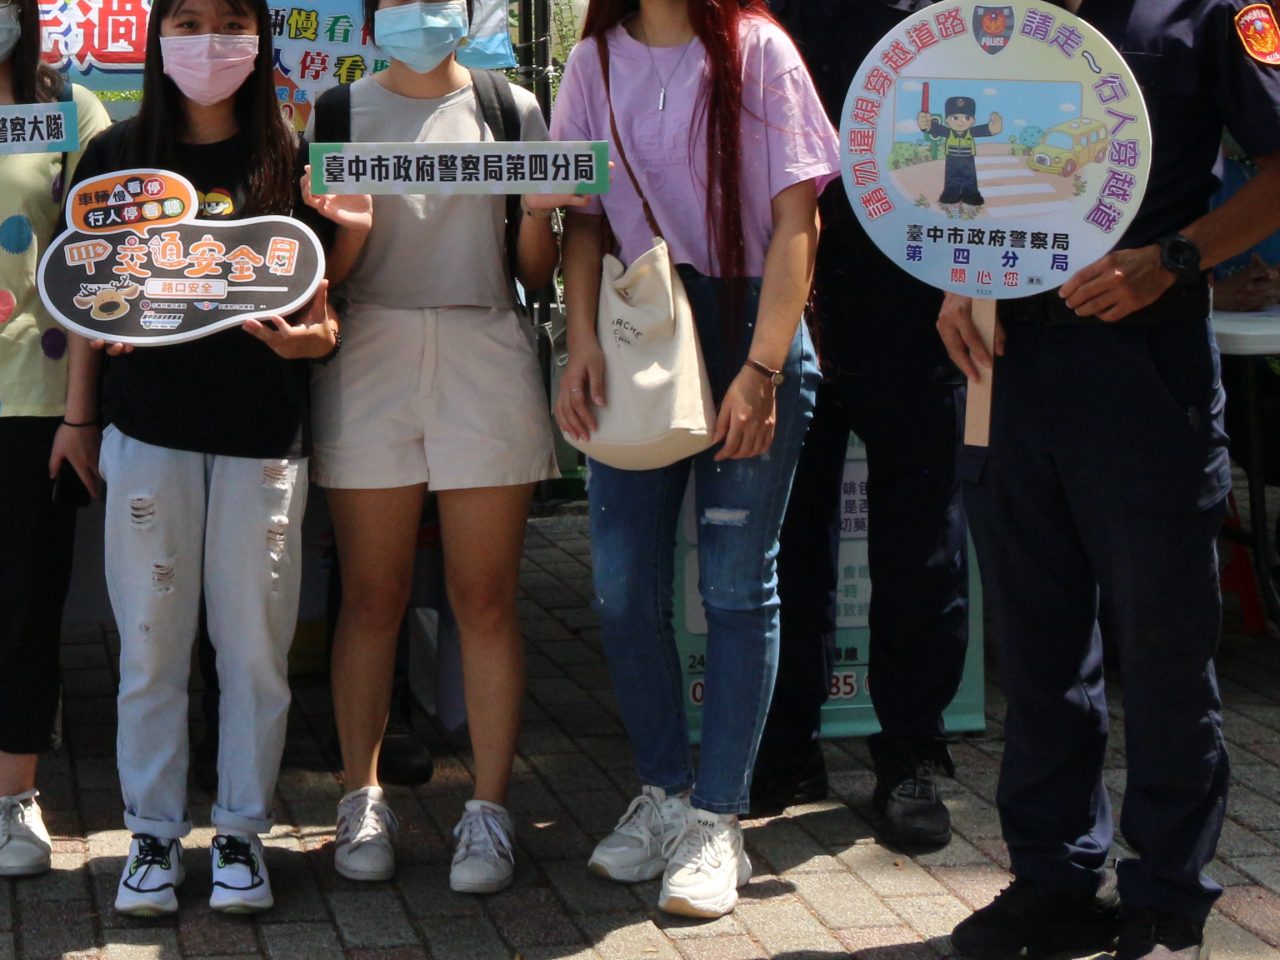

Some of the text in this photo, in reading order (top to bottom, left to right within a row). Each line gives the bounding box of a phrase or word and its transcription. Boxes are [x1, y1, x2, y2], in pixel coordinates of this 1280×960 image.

[981, 37, 1004, 47] POLICE
[325, 154, 594, 183] 臺中市政府警察局第四分局
[88, 198, 183, 226] 行人停看聽
[906, 224, 1070, 251] 臺中市政府警察局
[161, 282, 213, 294] 路口安全
